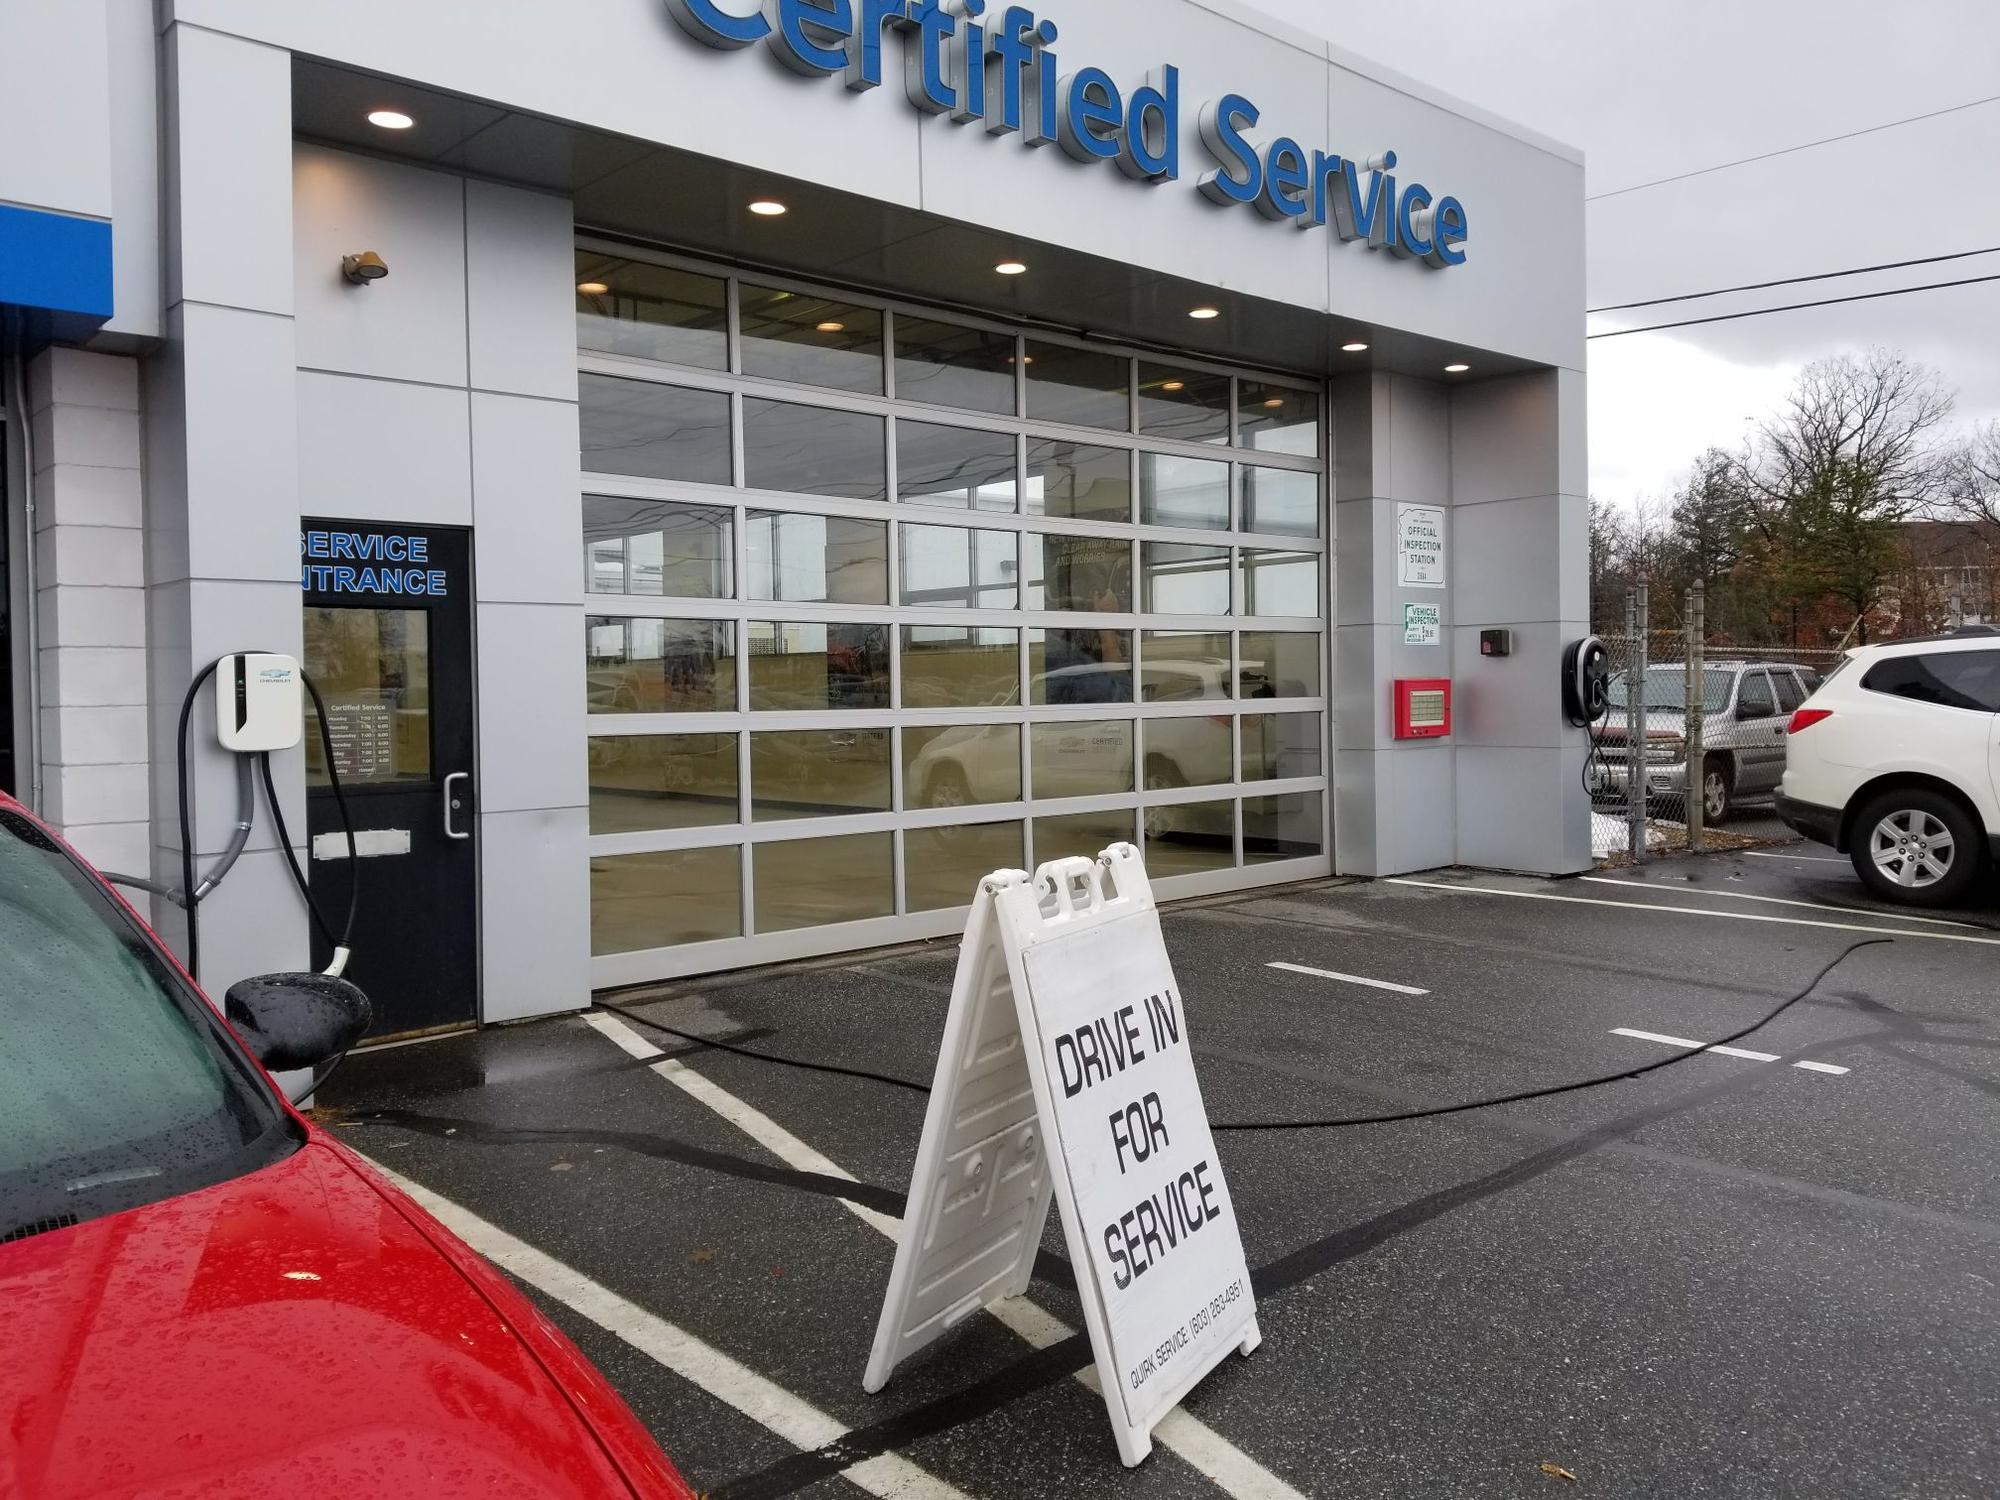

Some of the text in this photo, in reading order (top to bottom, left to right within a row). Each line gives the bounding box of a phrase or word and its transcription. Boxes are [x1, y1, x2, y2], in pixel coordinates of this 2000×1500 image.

[666, 0, 1467, 268] ertified Service
[300, 531, 428, 562] ERVICE
[1405, 540, 1441, 551] INSPECTION
[1408, 526, 1437, 537] OFFICIAL
[1410, 554, 1436, 564] STATION
[1408, 616, 1439, 625] INSPECTION
[1412, 607, 1437, 616] VEHICLE
[1054, 989, 1180, 1100] DRIVE IN
[1109, 1091, 1170, 1175] FOR
[1104, 1160, 1221, 1291] SERVICE
[1130, 1278, 1244, 1390] QUIRK SERVICE: (603) 263-4951
